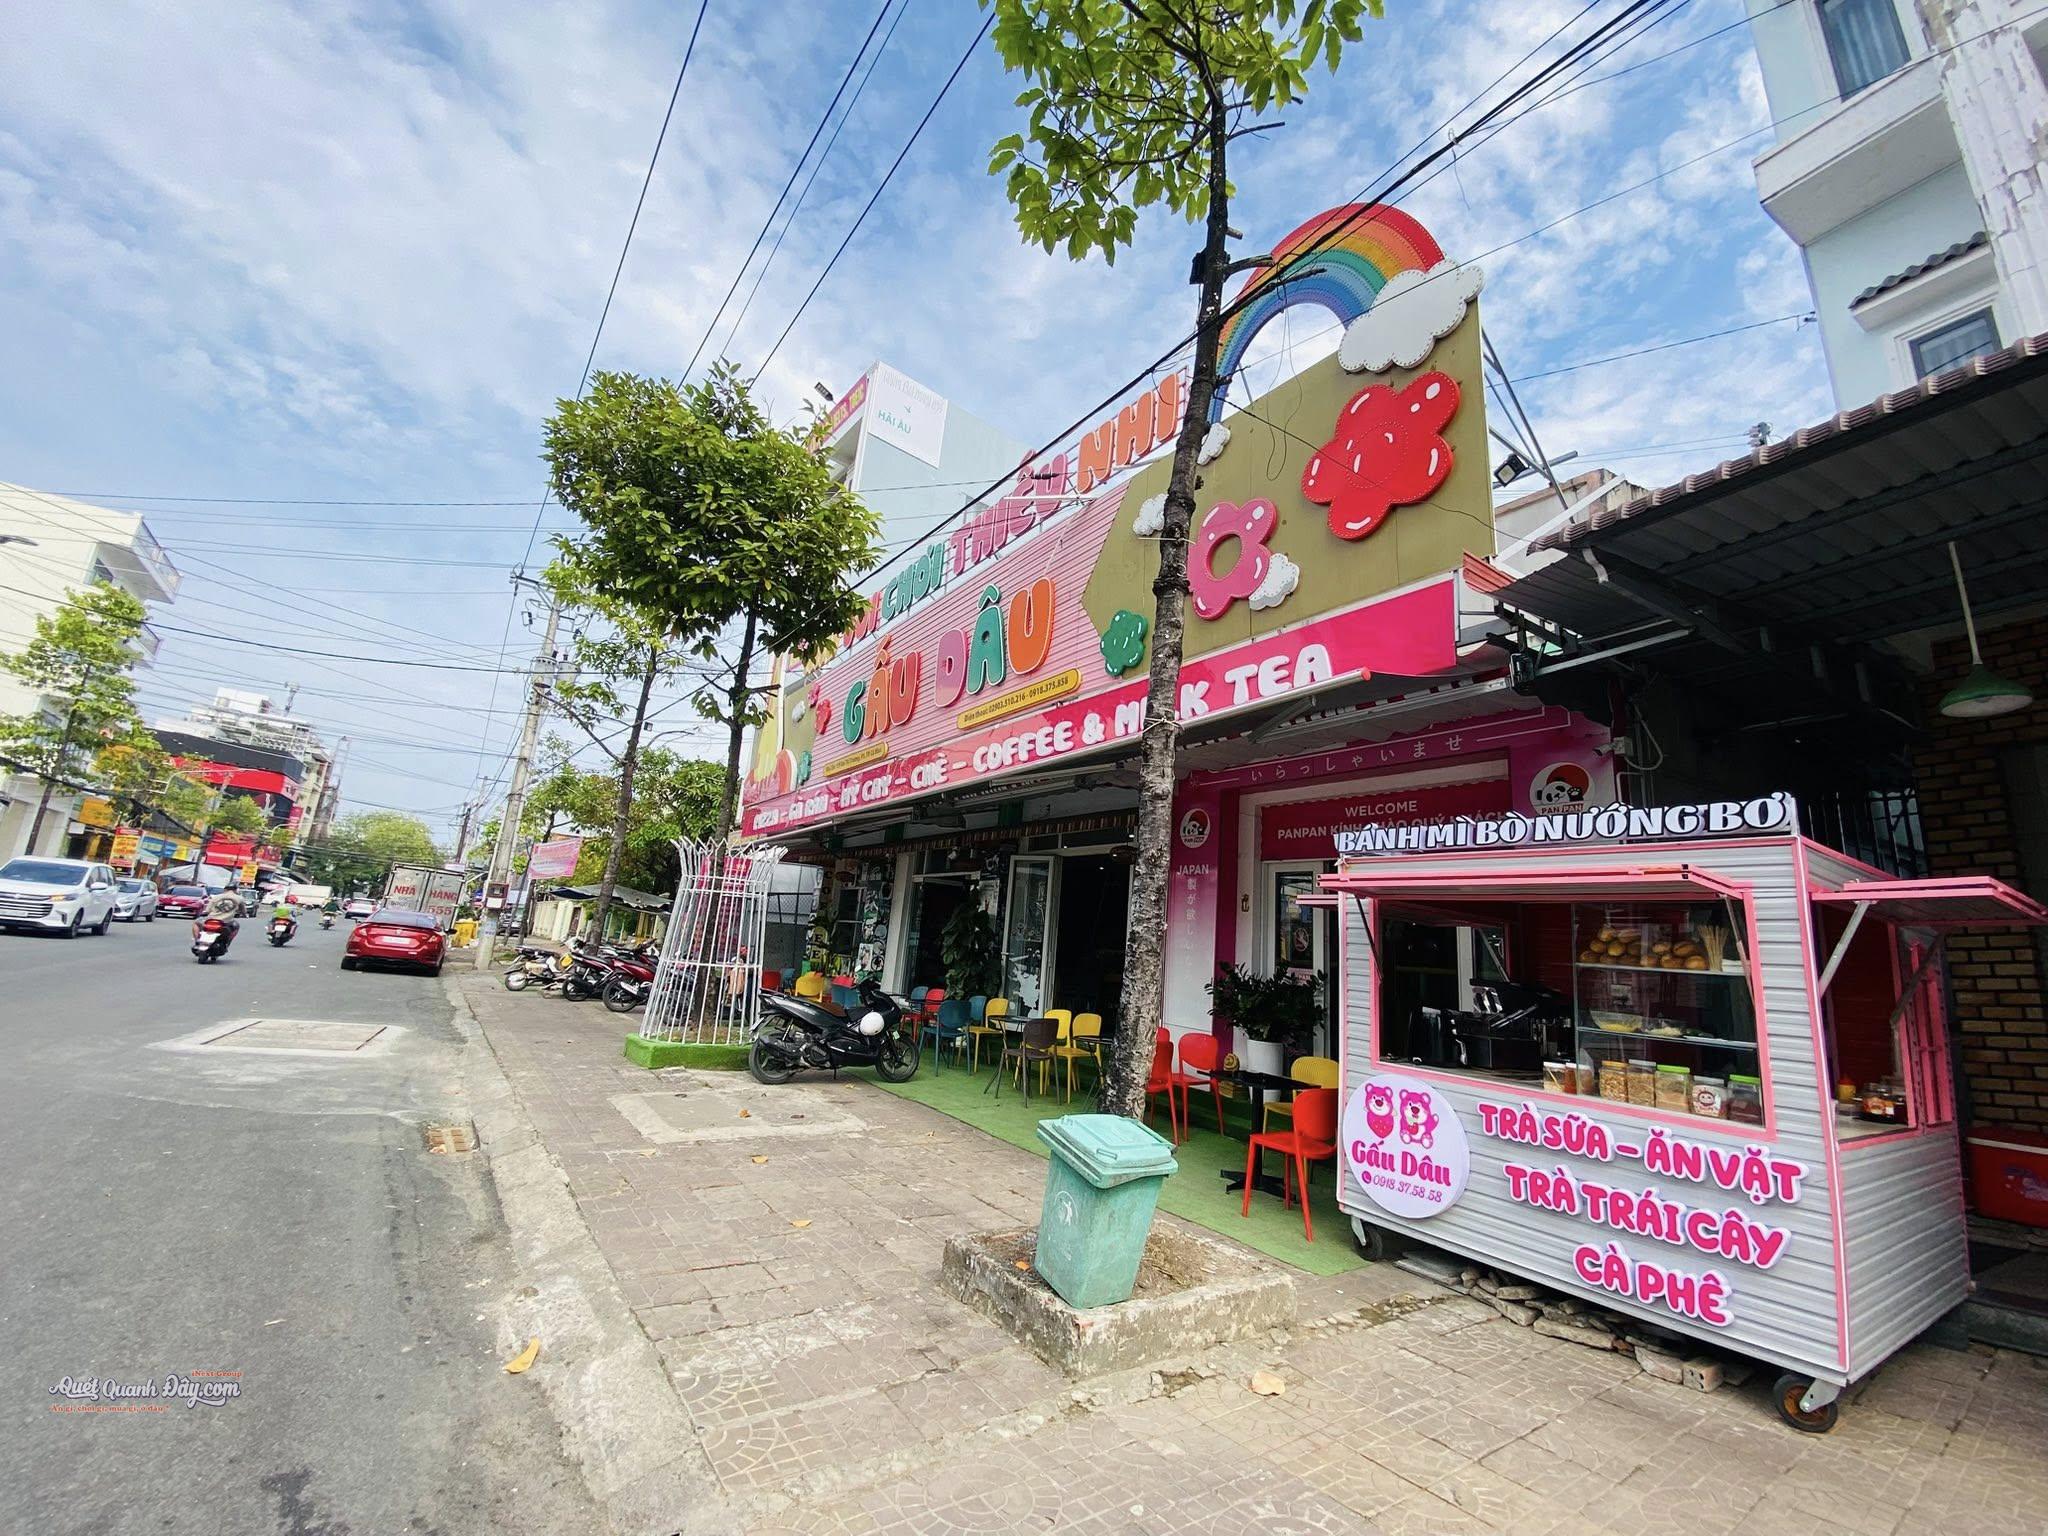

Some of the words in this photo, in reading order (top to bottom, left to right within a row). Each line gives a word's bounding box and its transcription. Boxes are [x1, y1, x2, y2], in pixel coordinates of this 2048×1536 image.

[951, 449, 1068, 576] THIẾU
[1077, 373, 1180, 494] NHI
[842, 634, 920, 744] GẤU
[935, 577, 1053, 707] DÂU
[861, 774, 893, 801] CAY
[911, 753, 949, 789] CHÈ
[973, 720, 1074, 773] COFFEE
[1082, 713, 1105, 746] &
[1225, 644, 1332, 706] TEA
[1251, 734, 1463, 782] いらっしゃいませ
[1278, 826, 1326, 840] PANPAN
[1338, 823, 1419, 851] BÁNH
[1426, 815, 1468, 848] MÌ
[1476, 811, 1527, 845] BÒ
[1534, 802, 1700, 842] NƯỚNG
[1708, 792, 1787, 832] BƠ
[1345, 801, 1417, 817] WELCOME
[1541, 806, 1562, 815] PAN
[1563, 803, 1584, 813] PAN
[1176, 863, 1209, 876] JAPAN
[428, 905, 452, 915] 555
[1351, 1140, 1396, 1173] Gấu
[1401, 1151, 1452, 1187] Dâu
[1477, 1102, 1540, 1146] TRÀ
[1542, 1112, 1614, 1162] SỮA
[1645, 1126, 1705, 1182] ĂN
[1708, 1146, 1808, 1204] VẶT
[1504, 1163, 1580, 1216] TRÀ
[1580, 1184, 1686, 1246] TRÁI
[1687, 1207, 1791, 1269] CÂY
[1573, 1240, 1632, 1297] CÀ
[1636, 1269, 1734, 1327] PHÊ
